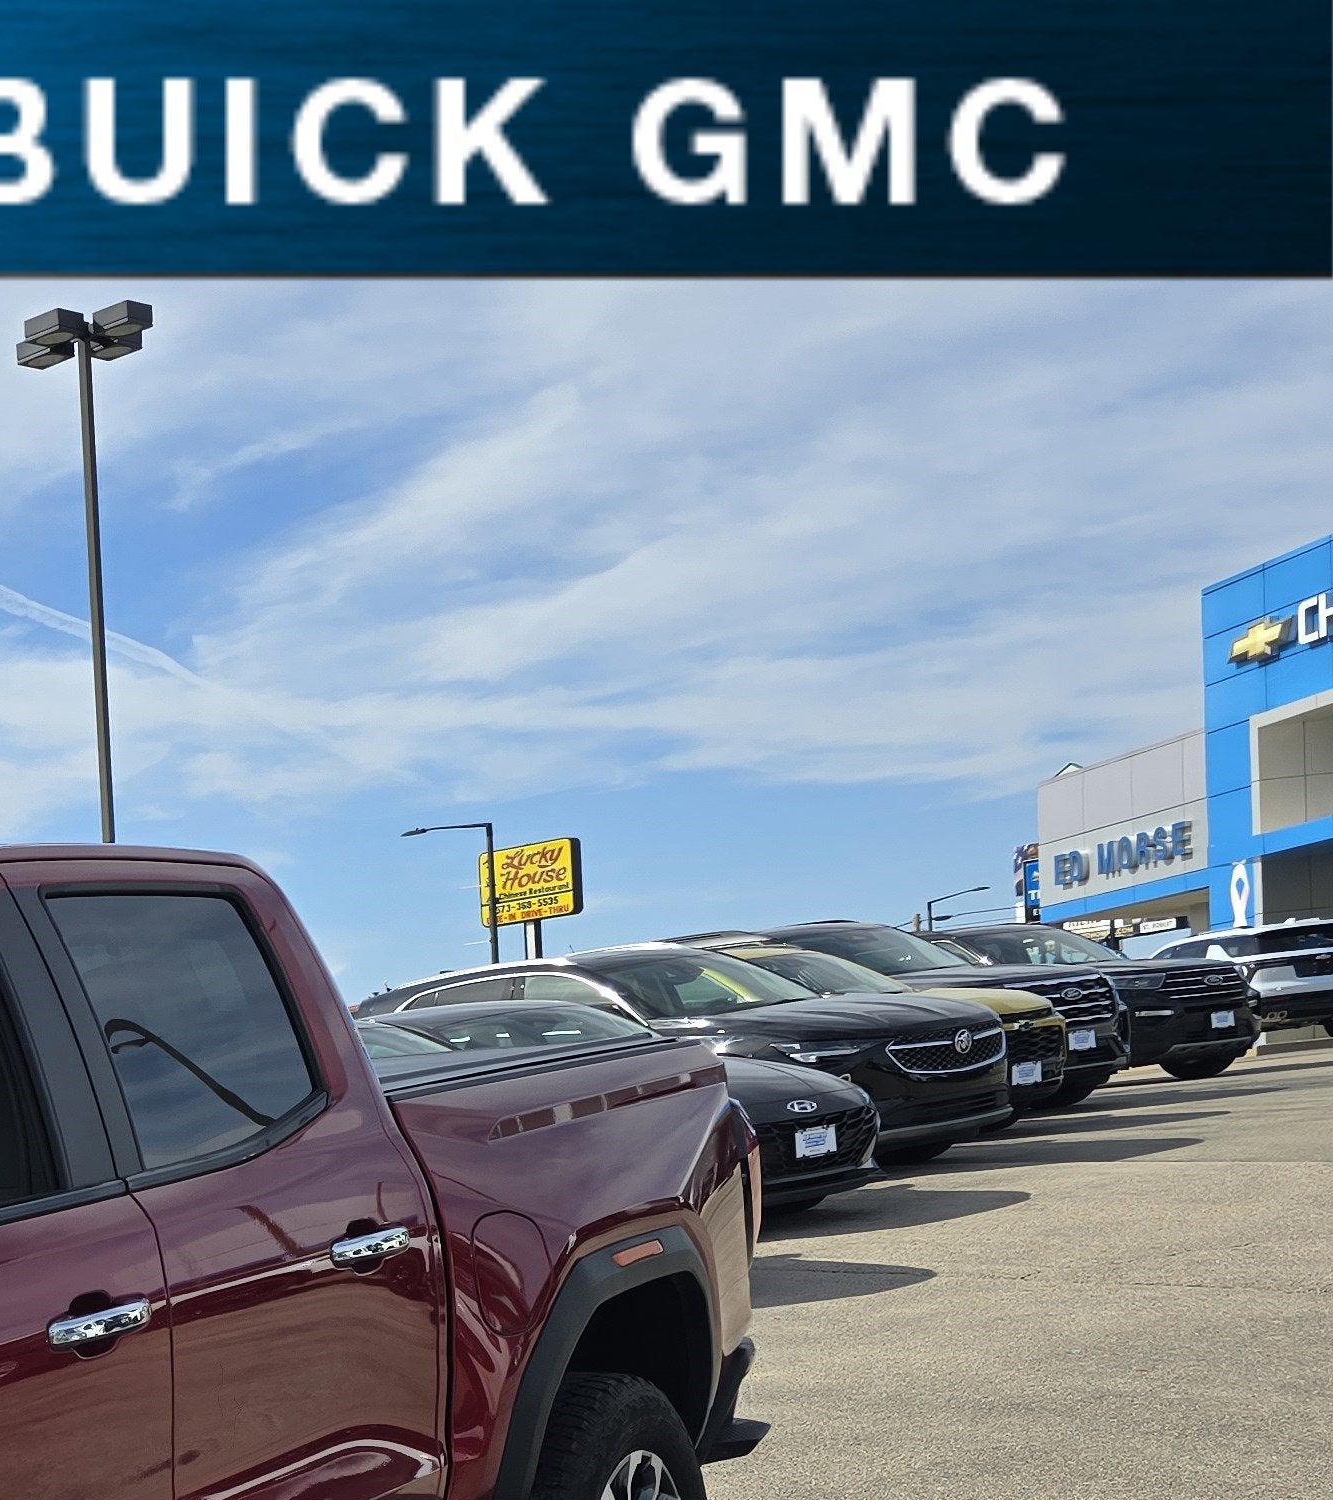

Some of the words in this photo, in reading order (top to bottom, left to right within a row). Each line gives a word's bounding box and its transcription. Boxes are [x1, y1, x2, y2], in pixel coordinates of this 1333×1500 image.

[501, 845, 565, 871] Lucky
[1054, 850, 1088, 887] ED
[1097, 821, 1193, 875] MORSE
[500, 866, 567, 891] House
[528, 881, 570, 896] Restaurant
